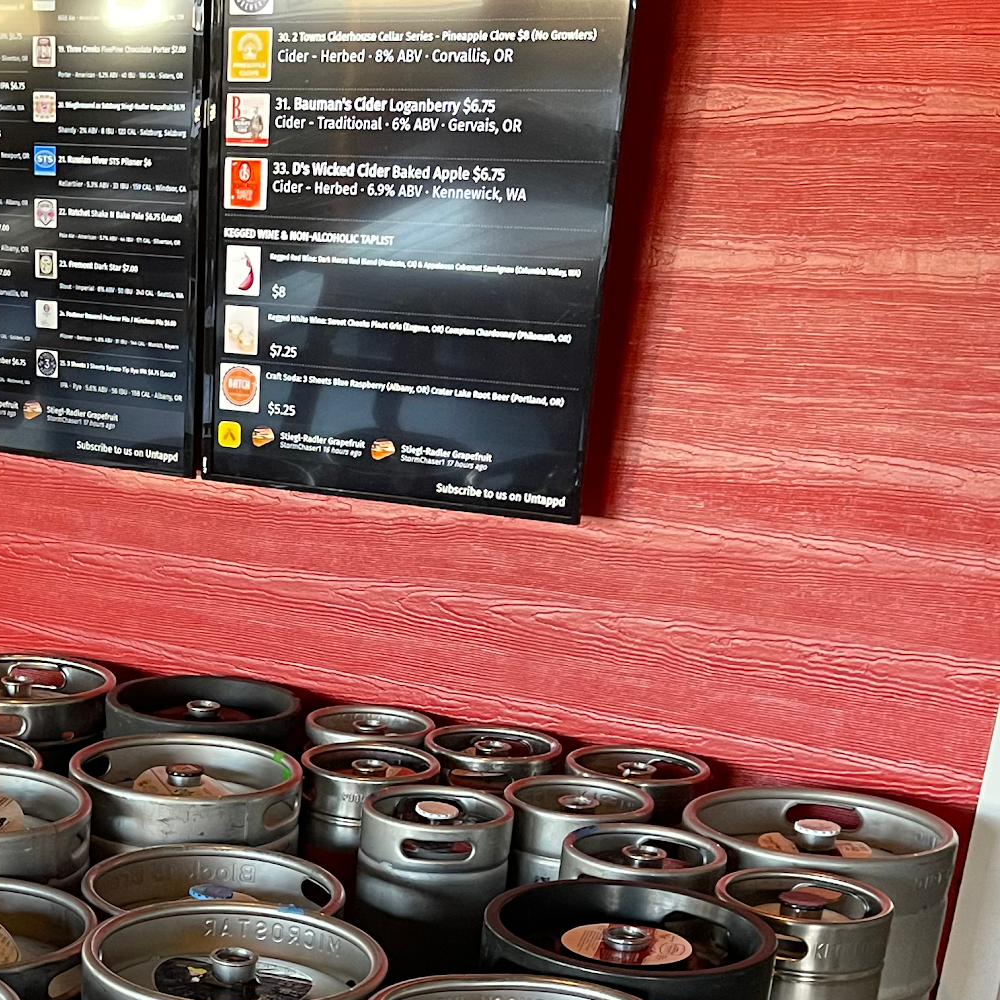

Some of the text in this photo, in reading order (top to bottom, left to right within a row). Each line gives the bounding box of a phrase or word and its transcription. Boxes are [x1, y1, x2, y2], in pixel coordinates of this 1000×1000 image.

[277, 28, 598, 43] 30. 2 Towns Ciderhouse Cellar Series Pineapple Clove $8 (No Growlers)
[277, 48, 514, 65] Cider Herbed 8% ABV Corvallis, OR
[274, 96, 496, 116] 31. Bauman's Cider Loganberry $6.75
[275, 115, 523, 135] Cider Traditional 6% ABV Gervais, OR
[37, 155, 53, 163] STS
[67, 155, 91, 165] Russian
[92, 156, 109, 165] River
[109, 157, 120, 166] STS
[120, 157, 143, 167] Pilsner
[143, 157, 153, 168] $6
[272, 161, 506, 183] 33. D's Wicked Cider Baked Apple $6.75
[272, 179, 528, 203] Cider Herbed 6.9% ABV Kennewick, WA
[223, 227, 395, 246] KEGGED WINE & NON-ALCOHOLIC TAPLIST
[59, 260, 139, 273] 23. Fremont Dark Star $7.00
[271, 283, 287, 299] $8
[269, 343, 298, 359] $7.25
[265, 371, 566, 408] Craft Soda: 3 Sheets Blue Raspberry (Albany, OR) Crater Lake Root Beer (Portland, OR)
[46, 405, 119, 422] Stiegl-Radler Grapefruit
[267, 401, 297, 417] $5.25
[280, 431, 365, 451] Stiegl-Radler Grapefruit
[76, 440, 179, 463] Subscribe to us on Untappd
[400, 444, 493, 464] Stiegl-Radler Grapefruit
[435, 483, 567, 508] Subscribe to us on Untappd
